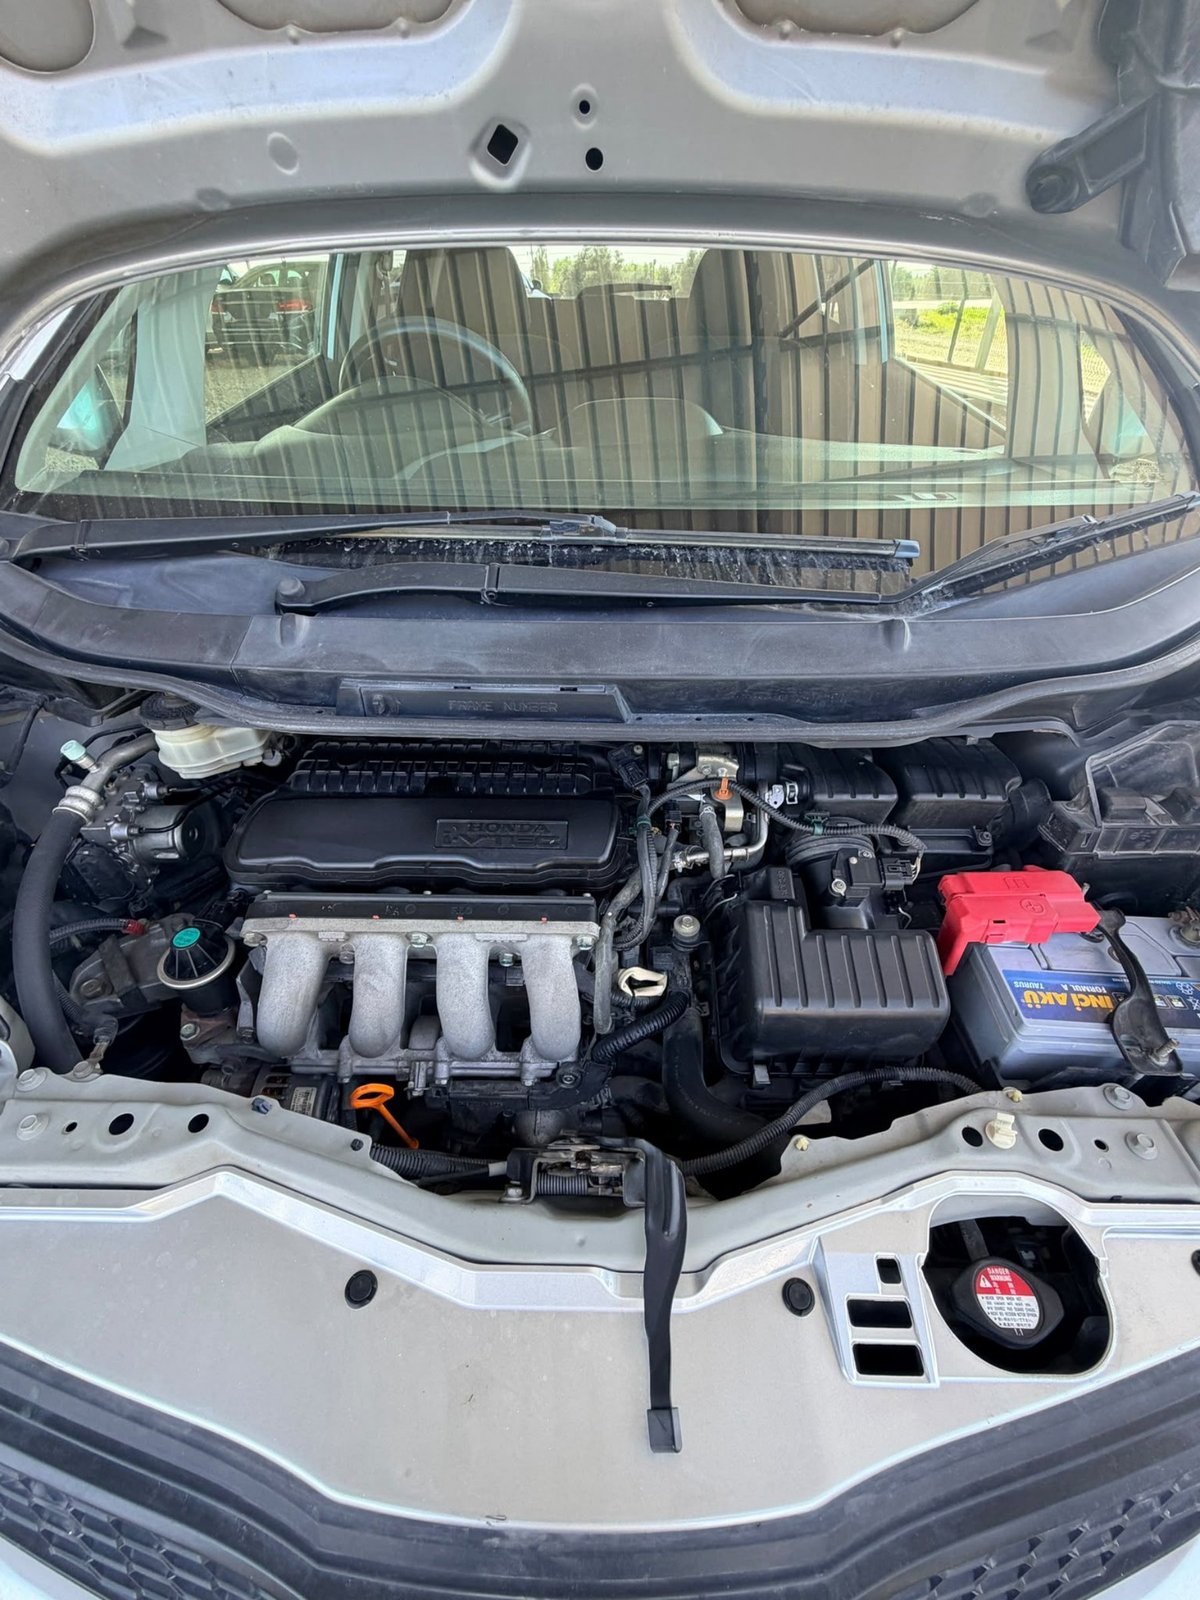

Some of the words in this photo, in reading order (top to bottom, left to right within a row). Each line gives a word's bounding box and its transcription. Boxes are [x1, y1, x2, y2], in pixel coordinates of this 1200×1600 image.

[448, 700, 494, 712] FRAME
[503, 702, 560, 713] NUMBER
[466, 823, 551, 833] HONDA
[1013, 981, 1044, 990] TAURUS
[1023, 990, 1068, 1009] AKÜ
[987, 1267, 1010, 1275] DANGER
